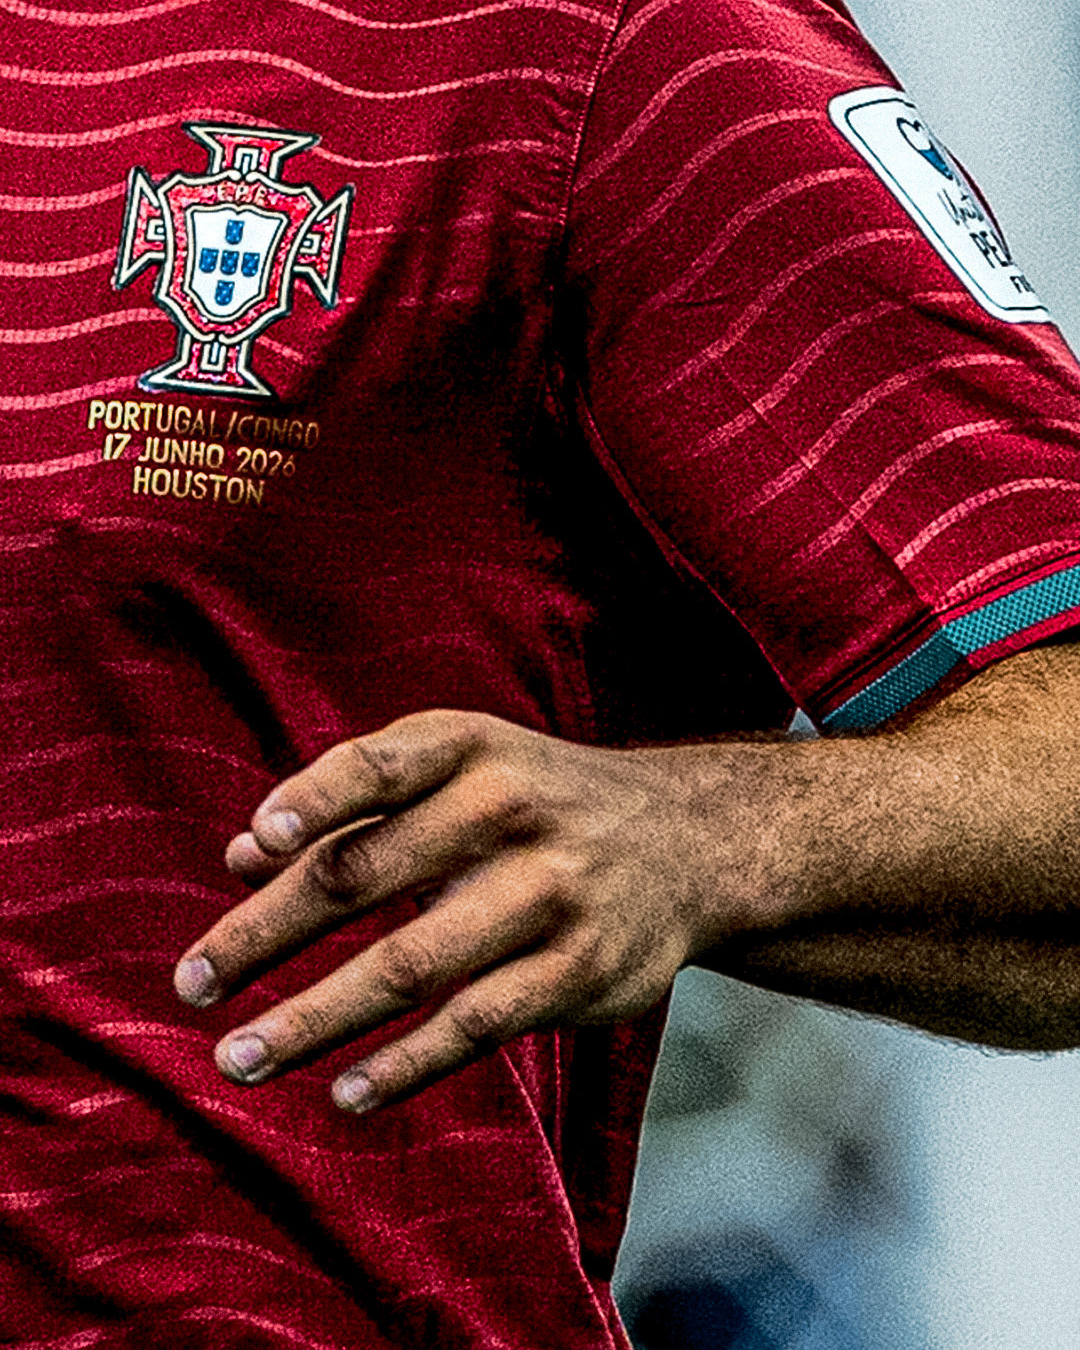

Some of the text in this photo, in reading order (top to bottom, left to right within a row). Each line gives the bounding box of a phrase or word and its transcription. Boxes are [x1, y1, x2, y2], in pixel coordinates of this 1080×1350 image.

[103, 433, 296, 477] 17 JUNHO 2026
[133, 465, 265, 504] HOUSTON
